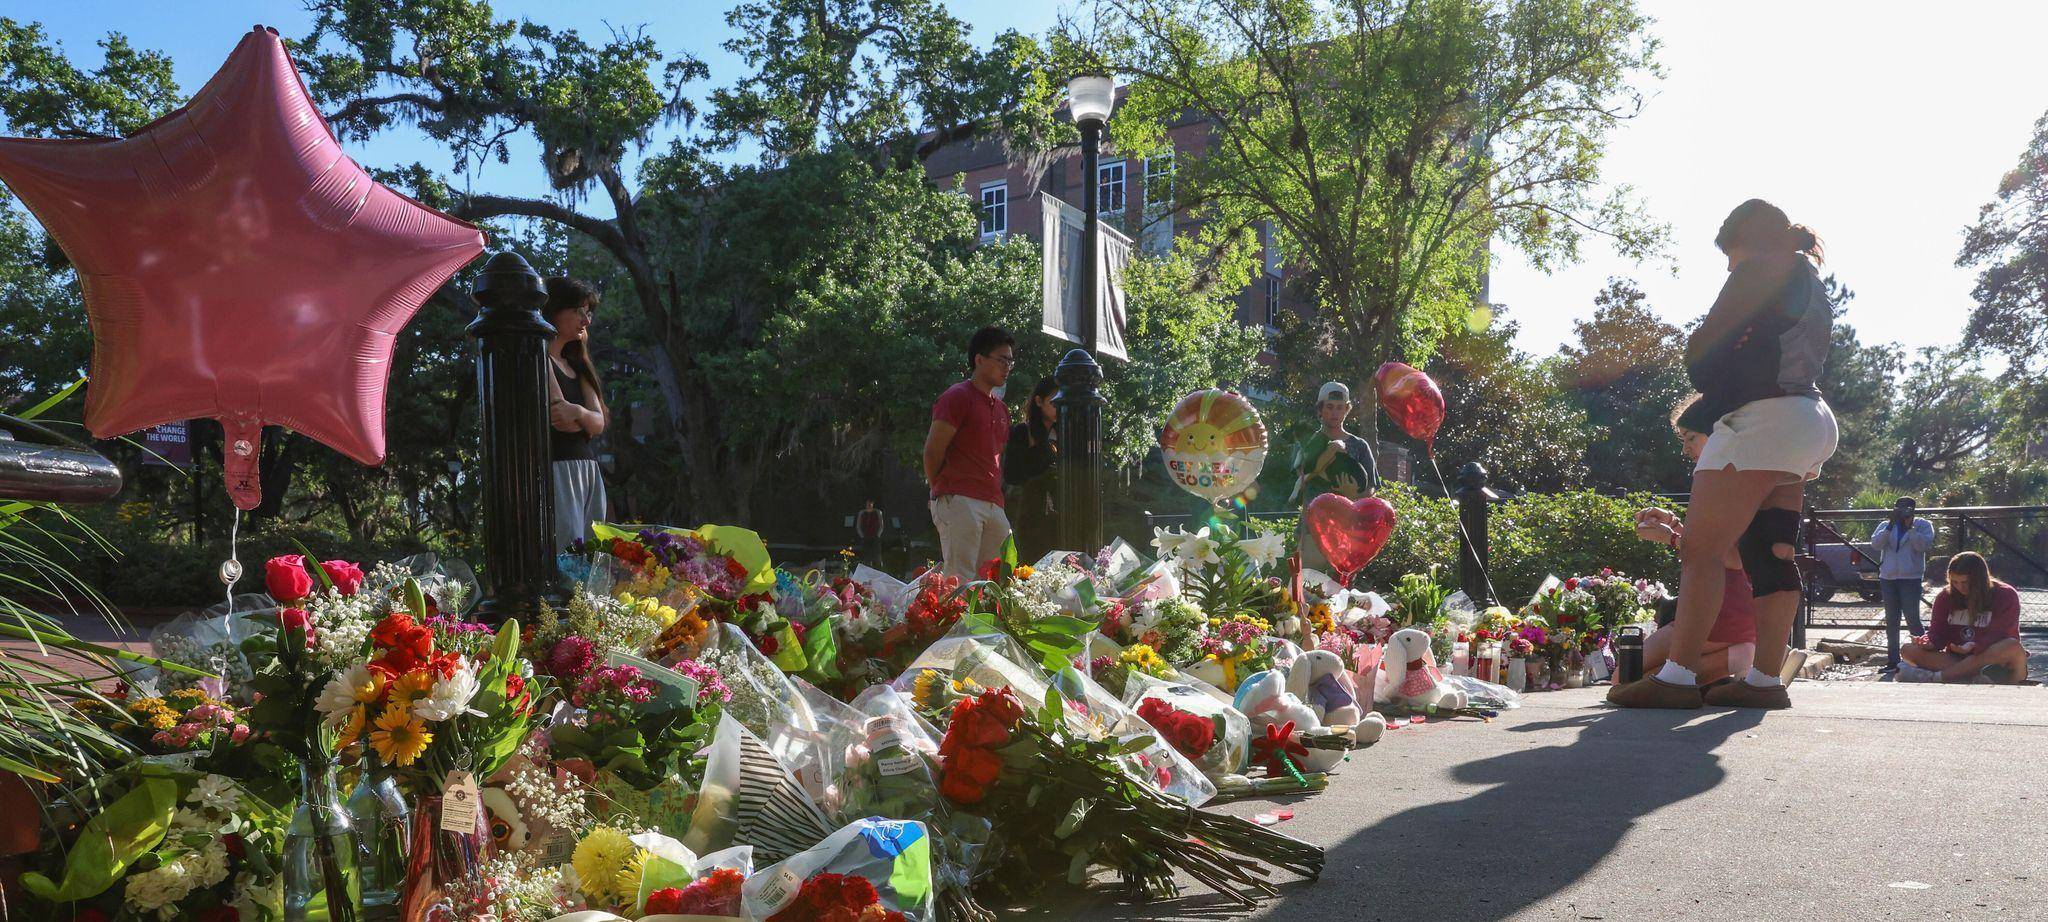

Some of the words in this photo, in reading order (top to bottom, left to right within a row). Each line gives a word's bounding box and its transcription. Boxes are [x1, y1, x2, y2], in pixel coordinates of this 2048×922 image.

[156, 426, 186, 435] CHANGE
[146, 433, 160, 441] THE
[160, 434, 186, 443] WORLD
[1170, 460, 1193, 472] GET
[1198, 461, 1239, 473] WELL
